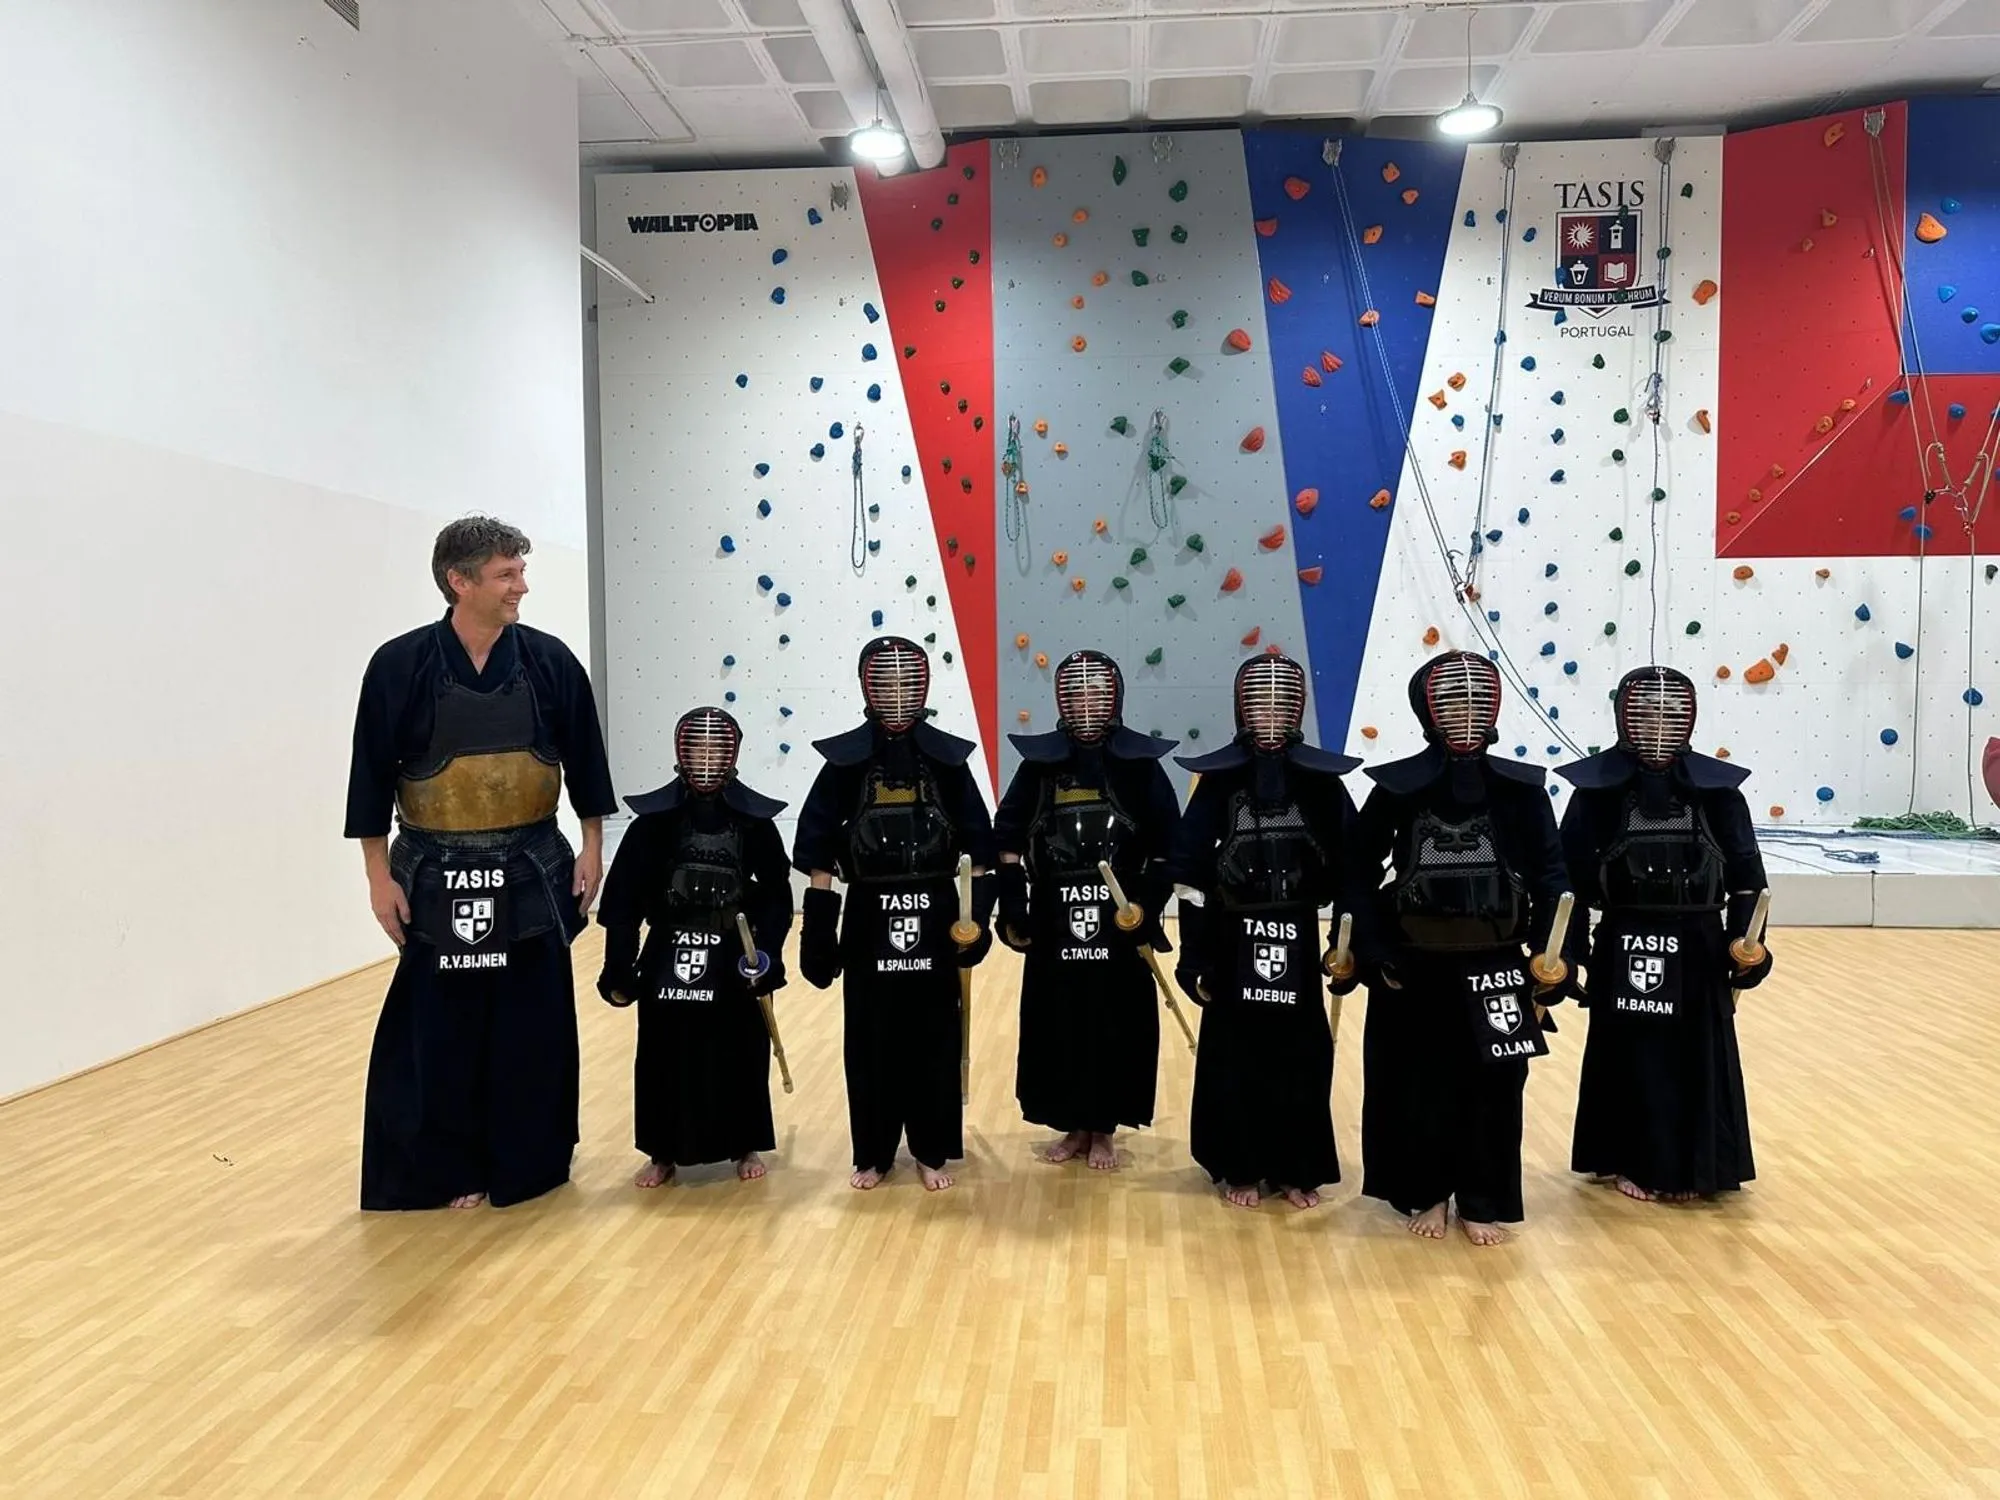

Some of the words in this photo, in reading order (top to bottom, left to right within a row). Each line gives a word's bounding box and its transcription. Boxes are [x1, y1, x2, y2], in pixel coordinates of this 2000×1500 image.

[1554, 180, 1645, 209] TASIS
[627, 213, 759, 234] WALLTOPIA
[1543, 291, 1573, 303] VERUM
[1575, 292, 1605, 304] BONUM
[1560, 325, 1635, 338] PORTUGAL
[443, 868, 505, 889] TASIS
[879, 893, 931, 910] TASIS
[1060, 885, 1110, 902] TASIS
[1243, 918, 1298, 940] TASIS
[1621, 934, 1679, 953] TASIS
[439, 952, 507, 969] R.V.BIJNEN
[1061, 947, 1109, 960] C.TAYLOR
[877, 957, 932, 972] M.SPALLONE
[1467, 968, 1525, 992] TASIS
[658, 987, 714, 1002] J.V.BIJNEN
[1242, 987, 1297, 1005] N.DEBUE
[1617, 997, 1674, 1015] H.BARAN
[1491, 1039, 1536, 1057] O.LAM
